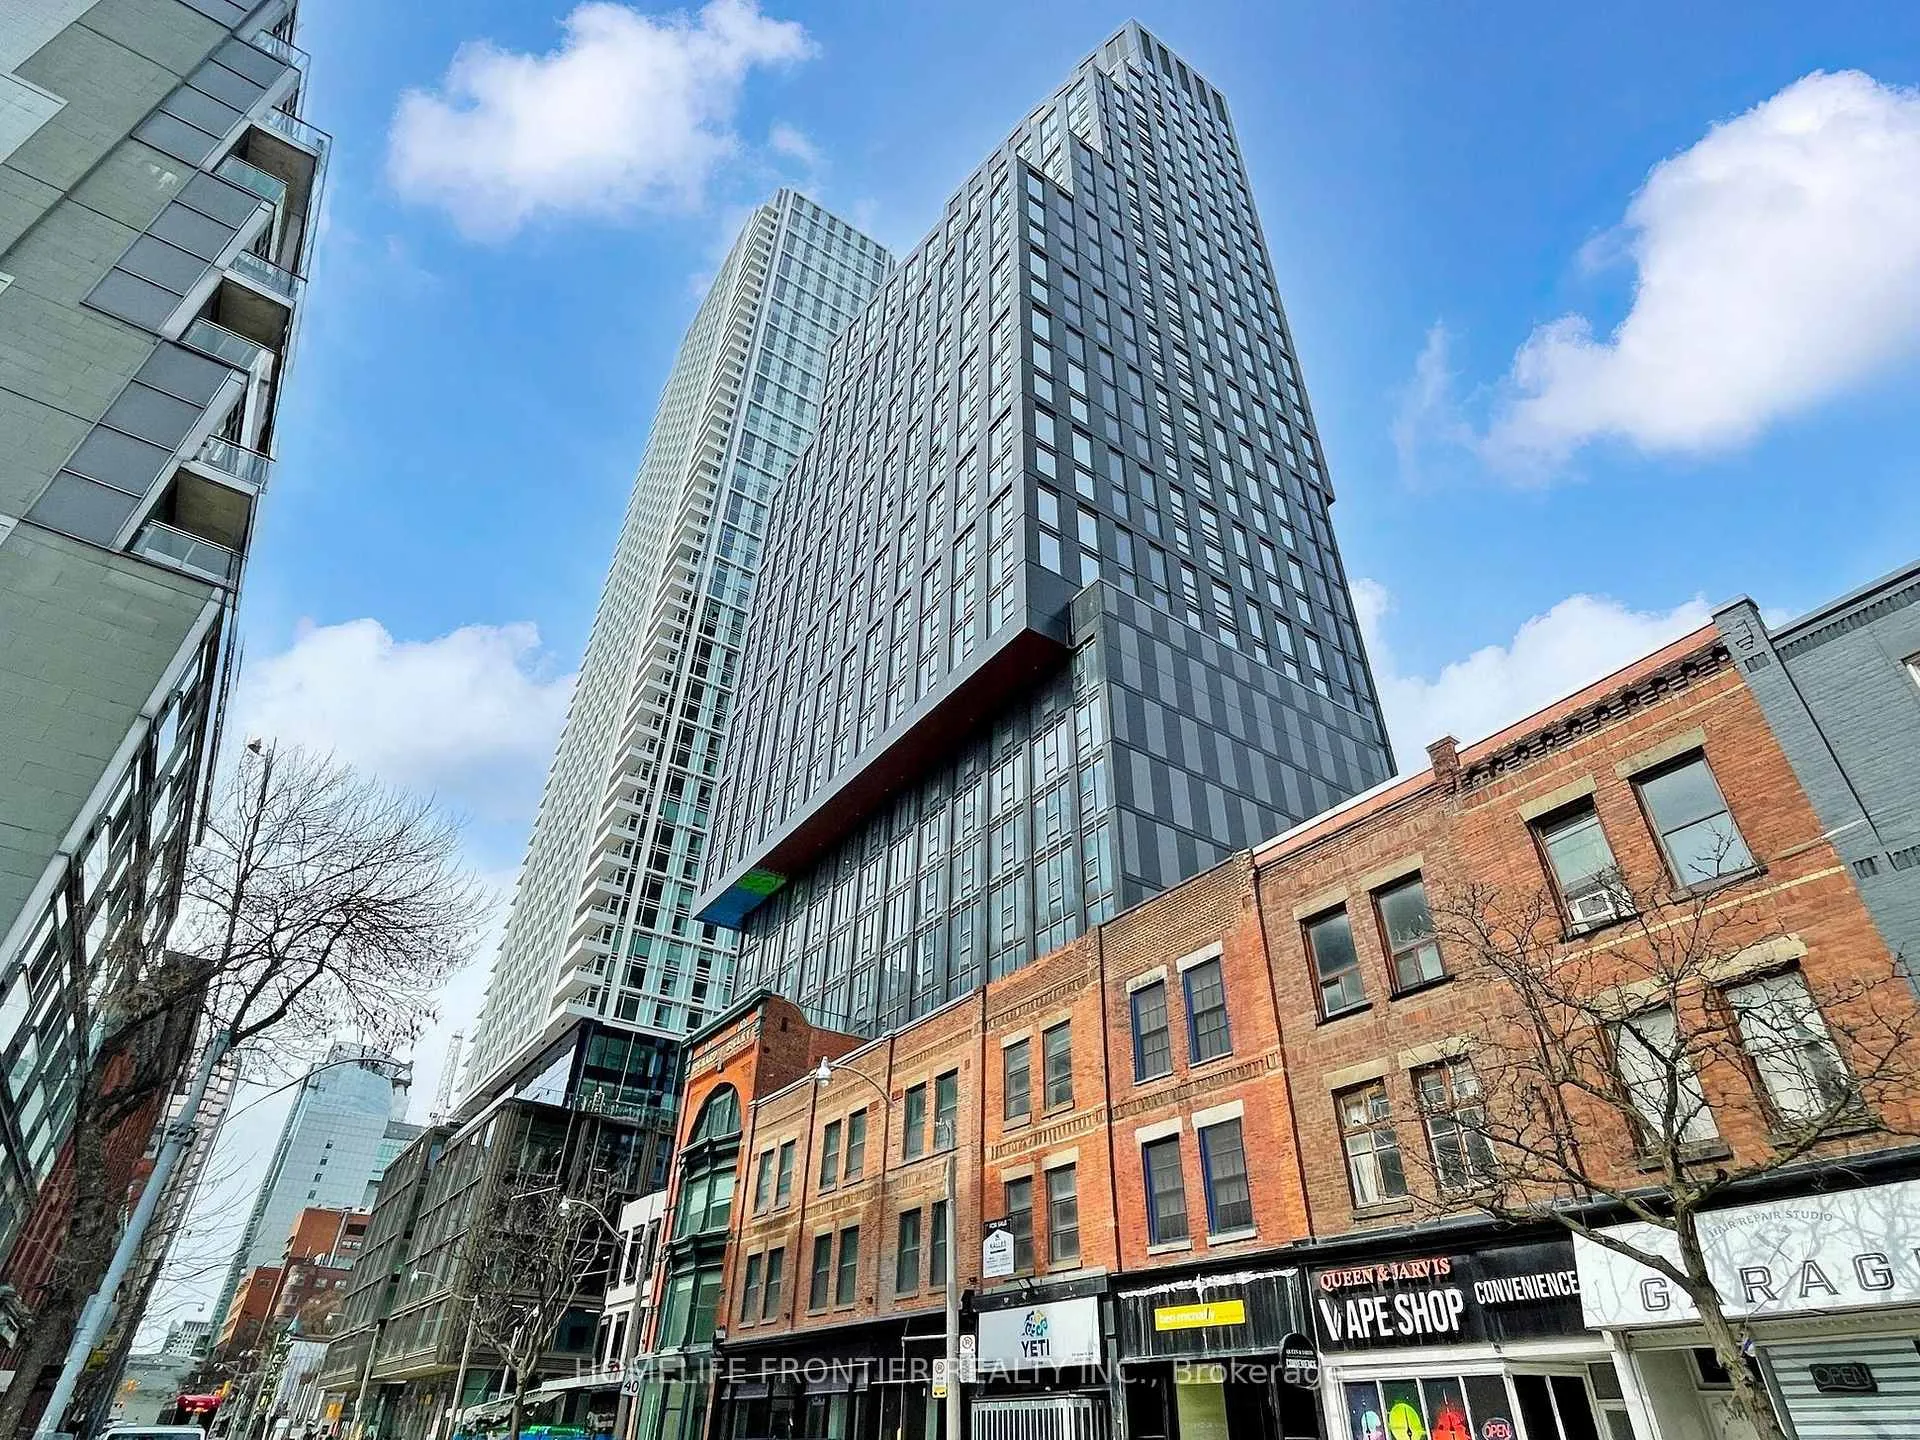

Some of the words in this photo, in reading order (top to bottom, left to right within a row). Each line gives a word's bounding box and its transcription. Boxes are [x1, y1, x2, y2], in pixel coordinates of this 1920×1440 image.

[1709, 1220, 1737, 1238] HAIR
[1739, 1210, 1781, 1226] REPAIR
[1785, 1209, 1833, 1222] STUDIO
[1320, 1267, 1374, 1292] QUEEN
[1375, 1264, 1390, 1282] &
[1390, 1257, 1451, 1280] JARVIS
[1473, 1270, 1581, 1305] CONVENIENCE
[1639, 1247, 1920, 1312] GRAG
[1317, 1296, 1394, 1342] VAPE
[1394, 1288, 1464, 1336] SHOP
[1021, 1338, 1050, 1358] YETI
[624, 1380, 639, 1393] 40
[1814, 1366, 1871, 1385] OPEN
[1485, 1424, 1511, 1438] OPEN
